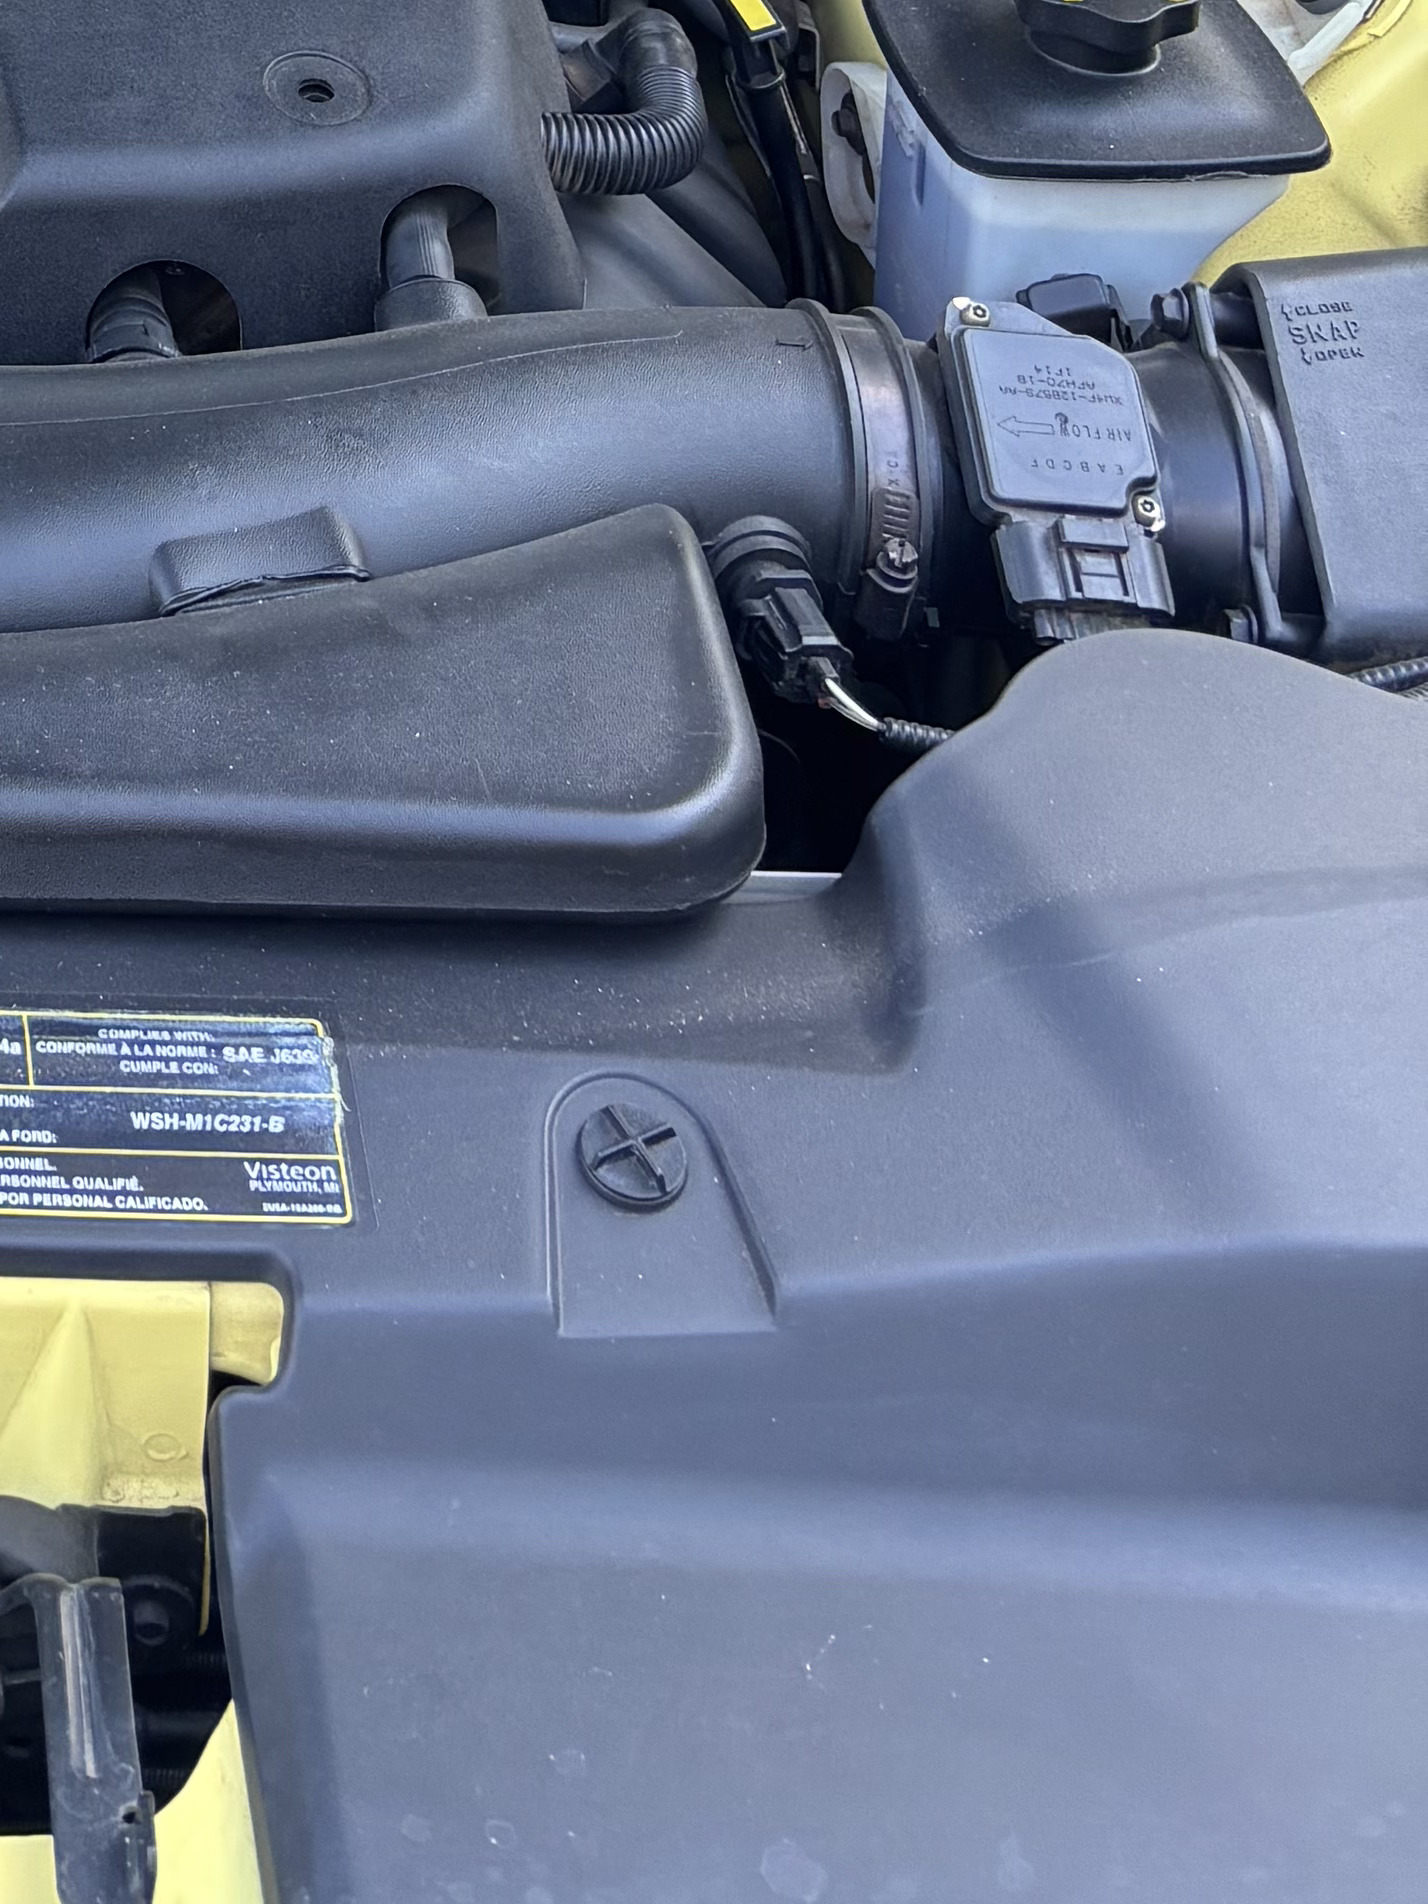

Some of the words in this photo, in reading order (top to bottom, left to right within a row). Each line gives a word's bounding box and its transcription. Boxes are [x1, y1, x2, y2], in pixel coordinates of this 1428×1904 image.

[1287, 319, 1359, 345] SNAP
[1107, 429, 1132, 442] AIR
[97, 1028, 171, 1040] COMPLIES
[35, 1041, 117, 1055] CONFORME
[133, 1044, 153, 1056] LA
[155, 1045, 207, 1058] NORME
[222, 1046, 265, 1063] SAE
[119, 1060, 179, 1073] CUMPLE
[181, 1062, 218, 1075] CON:
[129, 1110, 285, 1134] WSH-M1C231-B
[243, 1161, 336, 1181] Visteon
[249, 1179, 322, 1194] PLYMOUTH,
[32, 1192, 112, 1207] PERSONAL
[114, 1195, 208, 1210] CALIFICADO.
